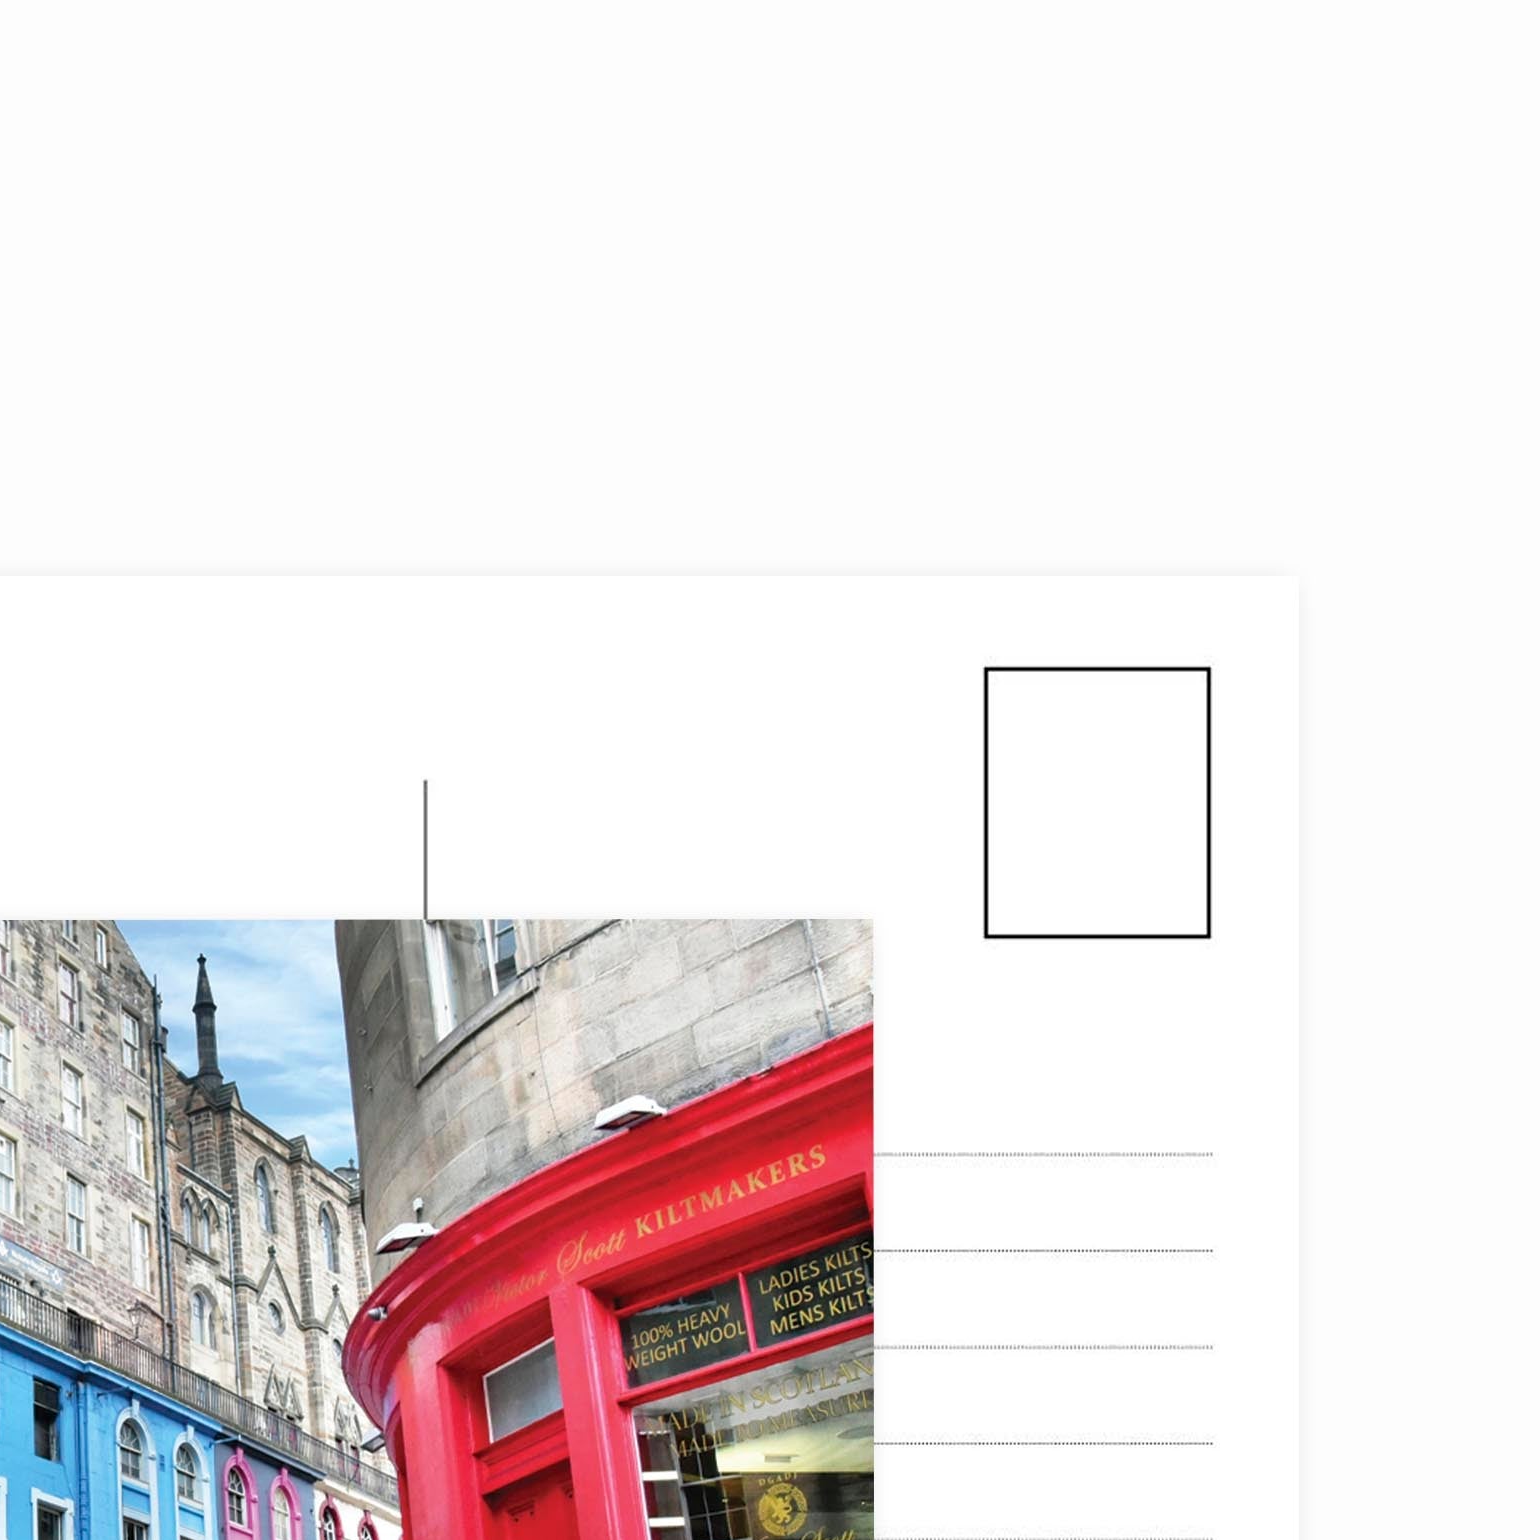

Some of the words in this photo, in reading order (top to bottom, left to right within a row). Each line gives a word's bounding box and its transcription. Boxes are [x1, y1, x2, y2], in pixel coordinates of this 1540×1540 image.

[556, 1230, 627, 1275] Scott
[634, 1144, 827, 1239] KILTMAKERS
[759, 1260, 820, 1295] LADIES
[824, 1241, 873, 1271] KILTS
[772, 1286, 814, 1312] KIDS
[818, 1267, 866, 1296] KILTS
[631, 1323, 674, 1350] 100%
[678, 1303, 731, 1332] HEAVY
[770, 1306, 824, 1335] MENS
[830, 1287, 874, 1319] KILTS
[623, 1338, 689, 1372] WEIGHT
[692, 1319, 746, 1350] WOOL
[719, 1389, 747, 1420] IN
